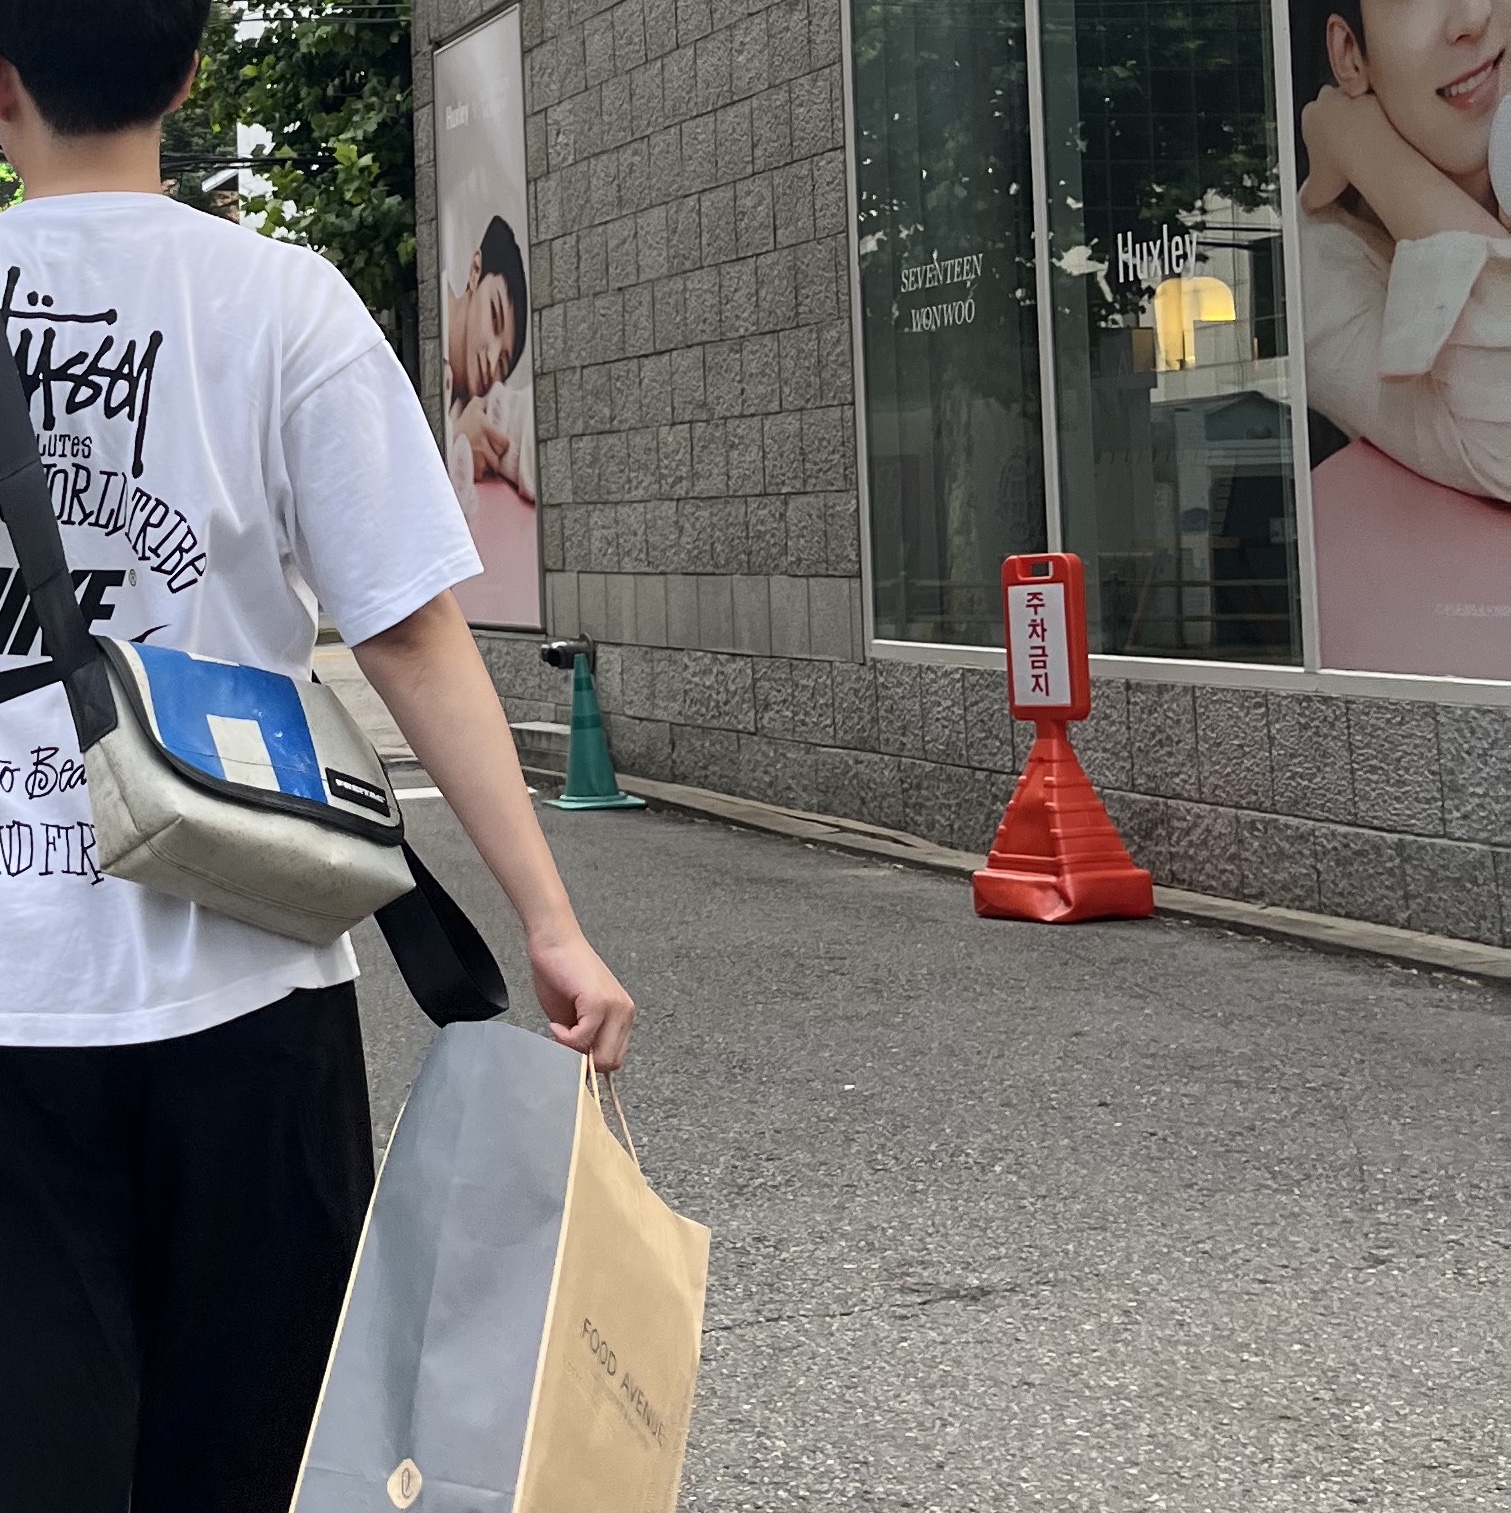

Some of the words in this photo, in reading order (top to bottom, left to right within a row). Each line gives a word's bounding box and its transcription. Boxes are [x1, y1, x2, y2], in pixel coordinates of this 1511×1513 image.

[900, 253, 984, 293] SEVENTEEN
[1117, 223, 1198, 284] Huxley
[911, 298, 976, 332] WONWOO
[42, 462, 129, 537] ORLD
[1025, 591, 1050, 697] 주차금지
[24, 745, 88, 800] Bea
[39, 820, 105, 886] FIR
[580, 1317, 617, 1376] FOOD
[620, 1371, 670, 1448] AVENUE
